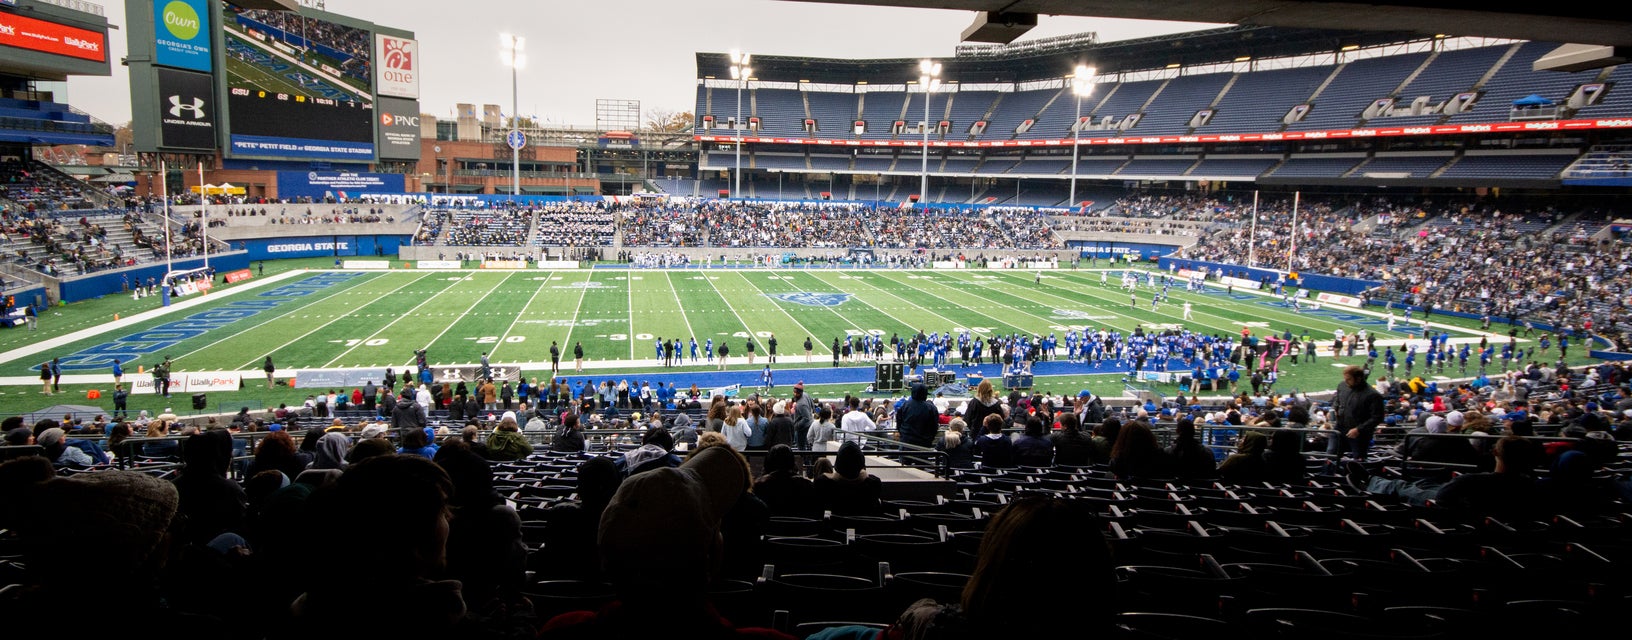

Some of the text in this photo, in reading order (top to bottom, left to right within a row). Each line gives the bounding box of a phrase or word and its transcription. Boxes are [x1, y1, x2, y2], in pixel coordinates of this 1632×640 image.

[166, 11, 197, 29] Own
[64, 36, 99, 52] WallyPark
[383, 70, 413, 84] one
[231, 87, 250, 97] GSU
[394, 115, 419, 127] PNC
[304, 145, 330, 153] GEORGIA
[267, 242, 348, 253] GEORGIA STATE
[190, 378, 234, 387] WallyPark
